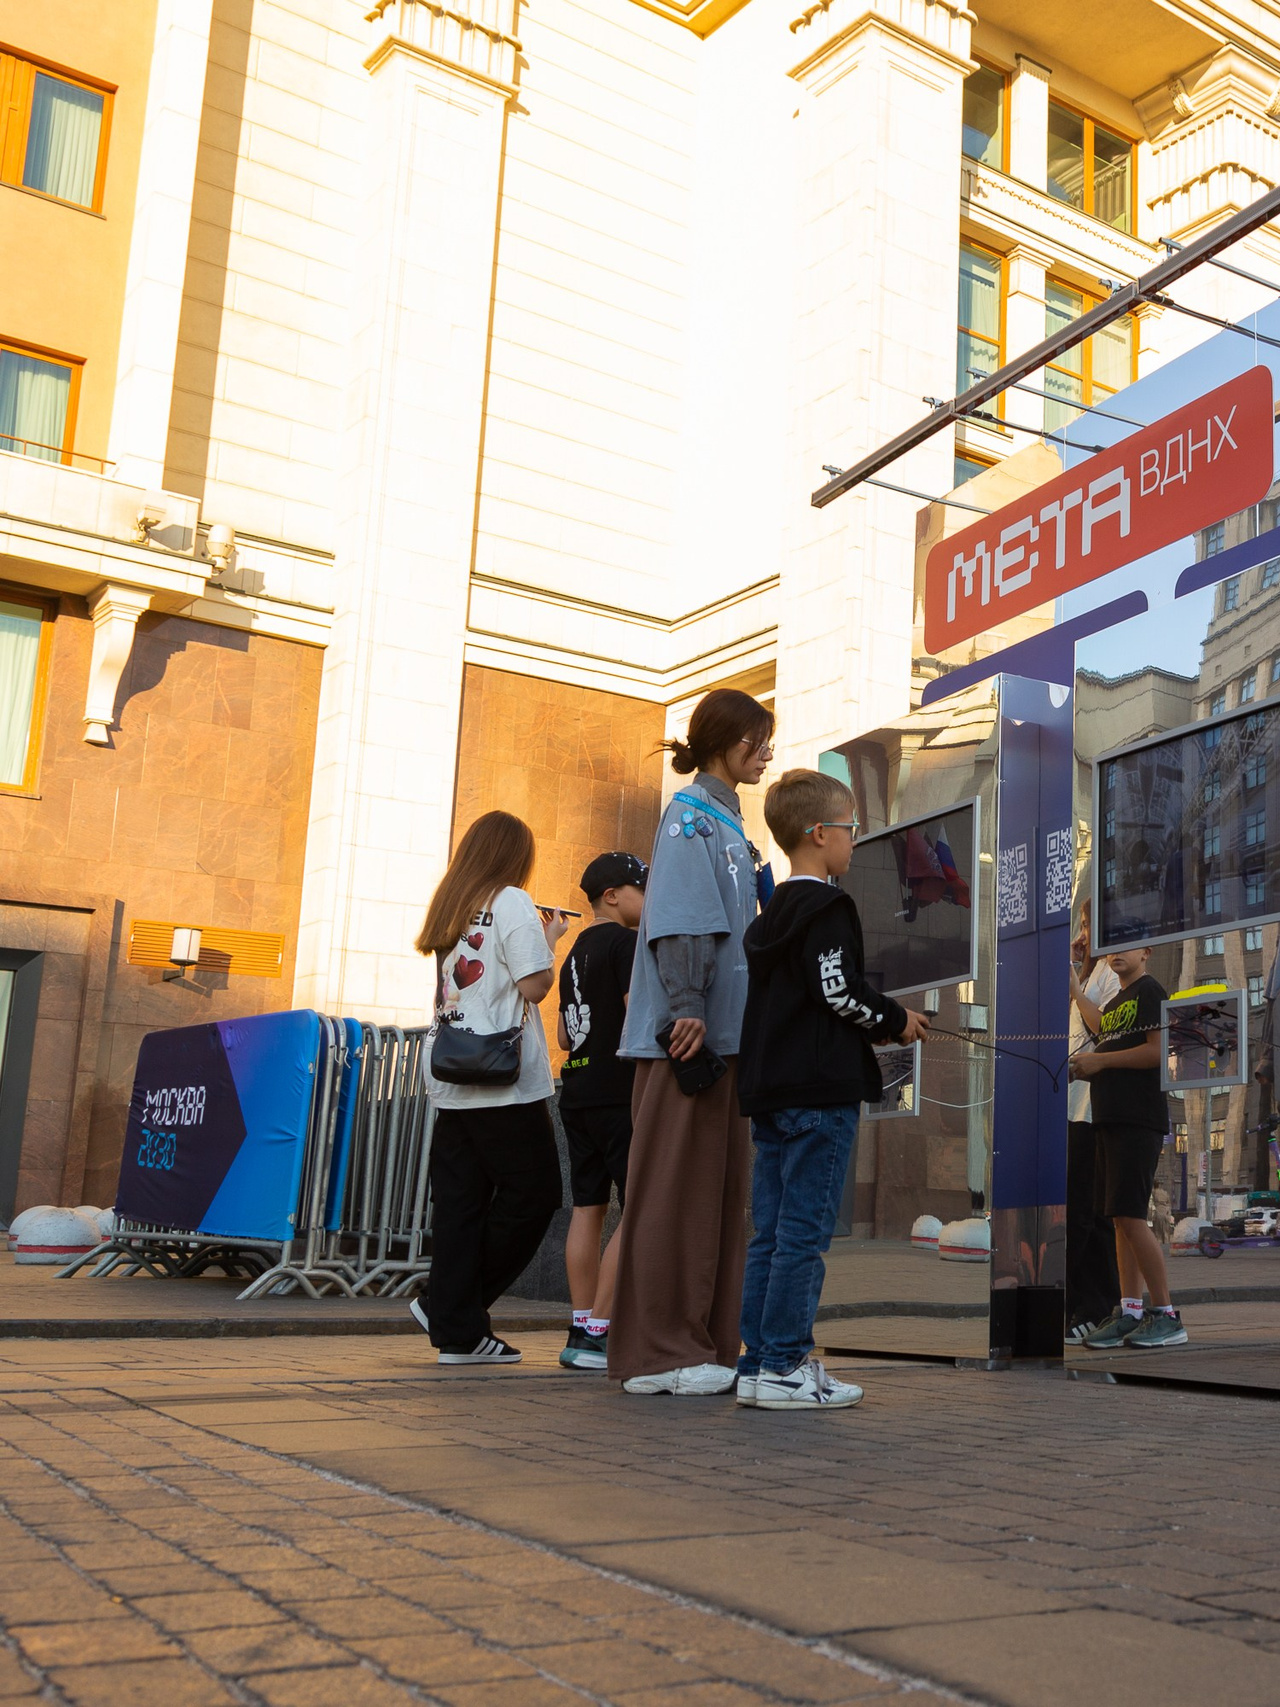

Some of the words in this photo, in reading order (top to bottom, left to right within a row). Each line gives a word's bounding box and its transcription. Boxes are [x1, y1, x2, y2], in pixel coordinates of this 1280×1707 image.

[946, 464, 1131, 624] МЕТА
[1139, 404, 1239, 497] ВДНХ
[141, 1085, 206, 1126] МОСКВА
[137, 1128, 177, 1171] 2030
